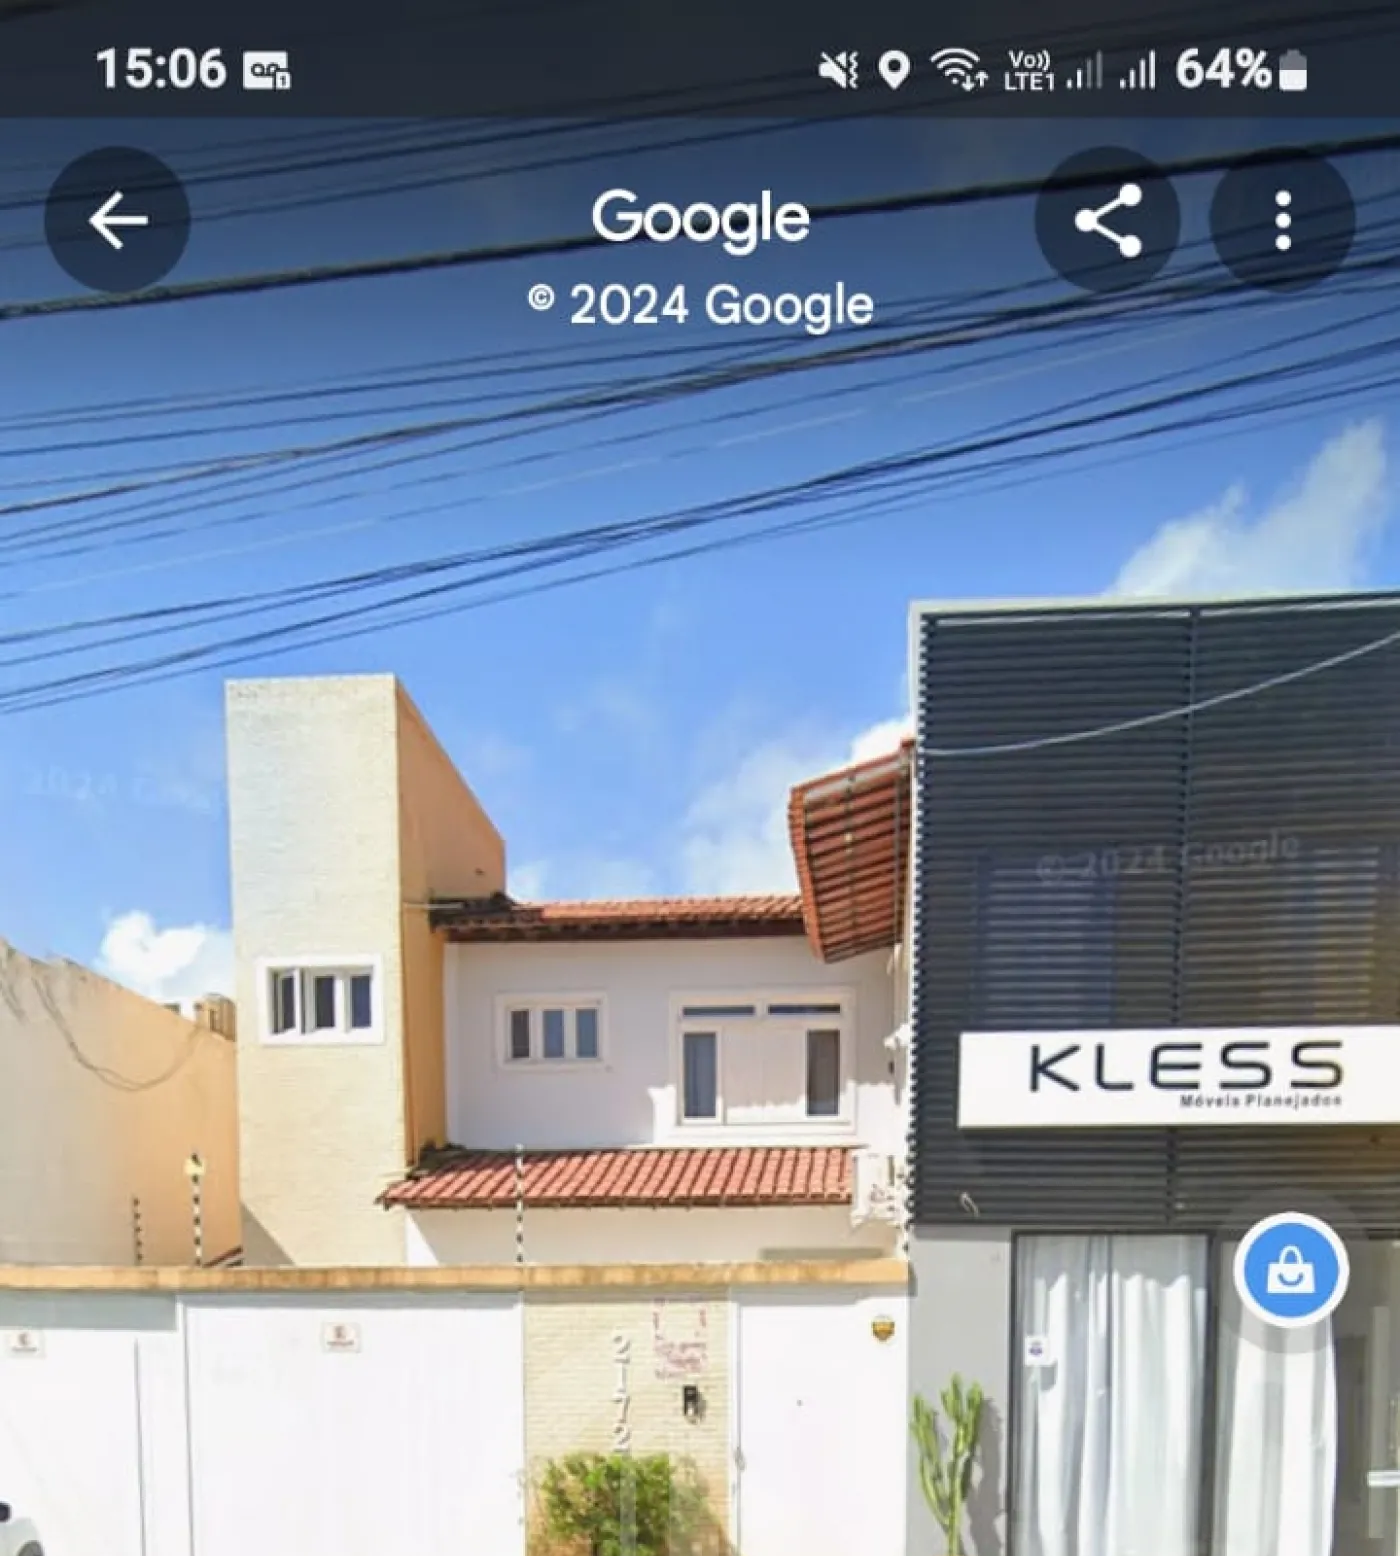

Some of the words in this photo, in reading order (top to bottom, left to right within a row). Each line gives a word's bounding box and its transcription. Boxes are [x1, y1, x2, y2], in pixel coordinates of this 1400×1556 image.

[1031, 1042, 1341, 1091] KLESS
[1245, 1093, 1342, 1111] Planejados
[611, 1333, 631, 1455] 2172
